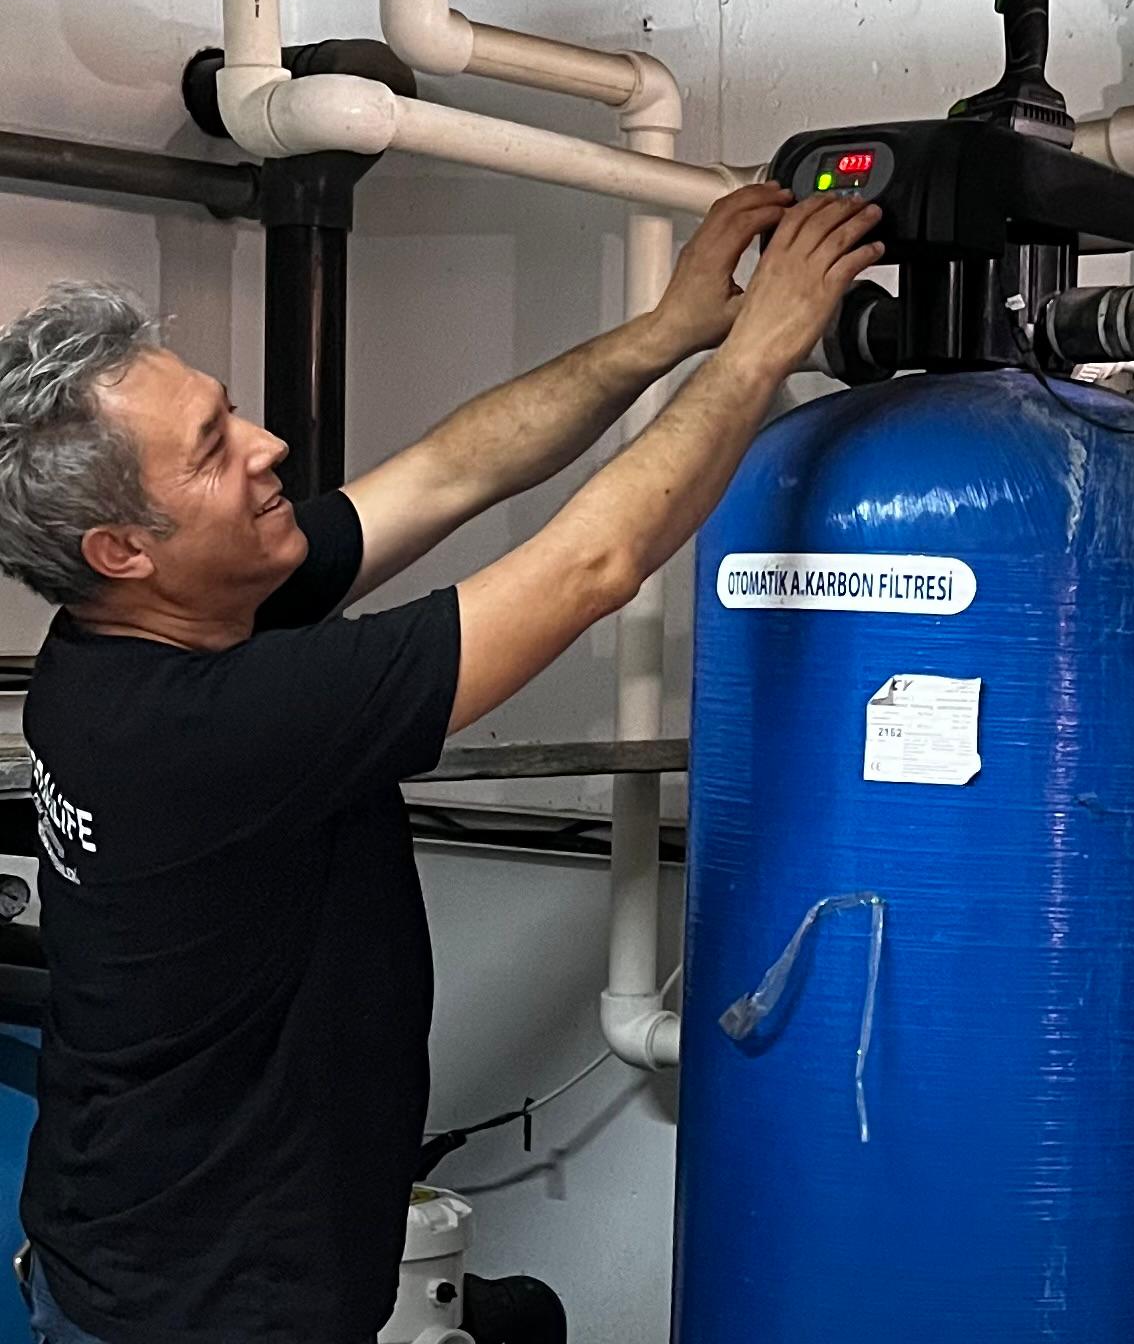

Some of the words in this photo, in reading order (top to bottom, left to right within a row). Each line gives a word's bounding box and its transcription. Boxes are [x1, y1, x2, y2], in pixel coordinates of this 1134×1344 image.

[727, 565, 787, 596] OTOMATİK
[790, 570, 874, 598] A.KARBON
[878, 567, 954, 602] FİLTRESİ
